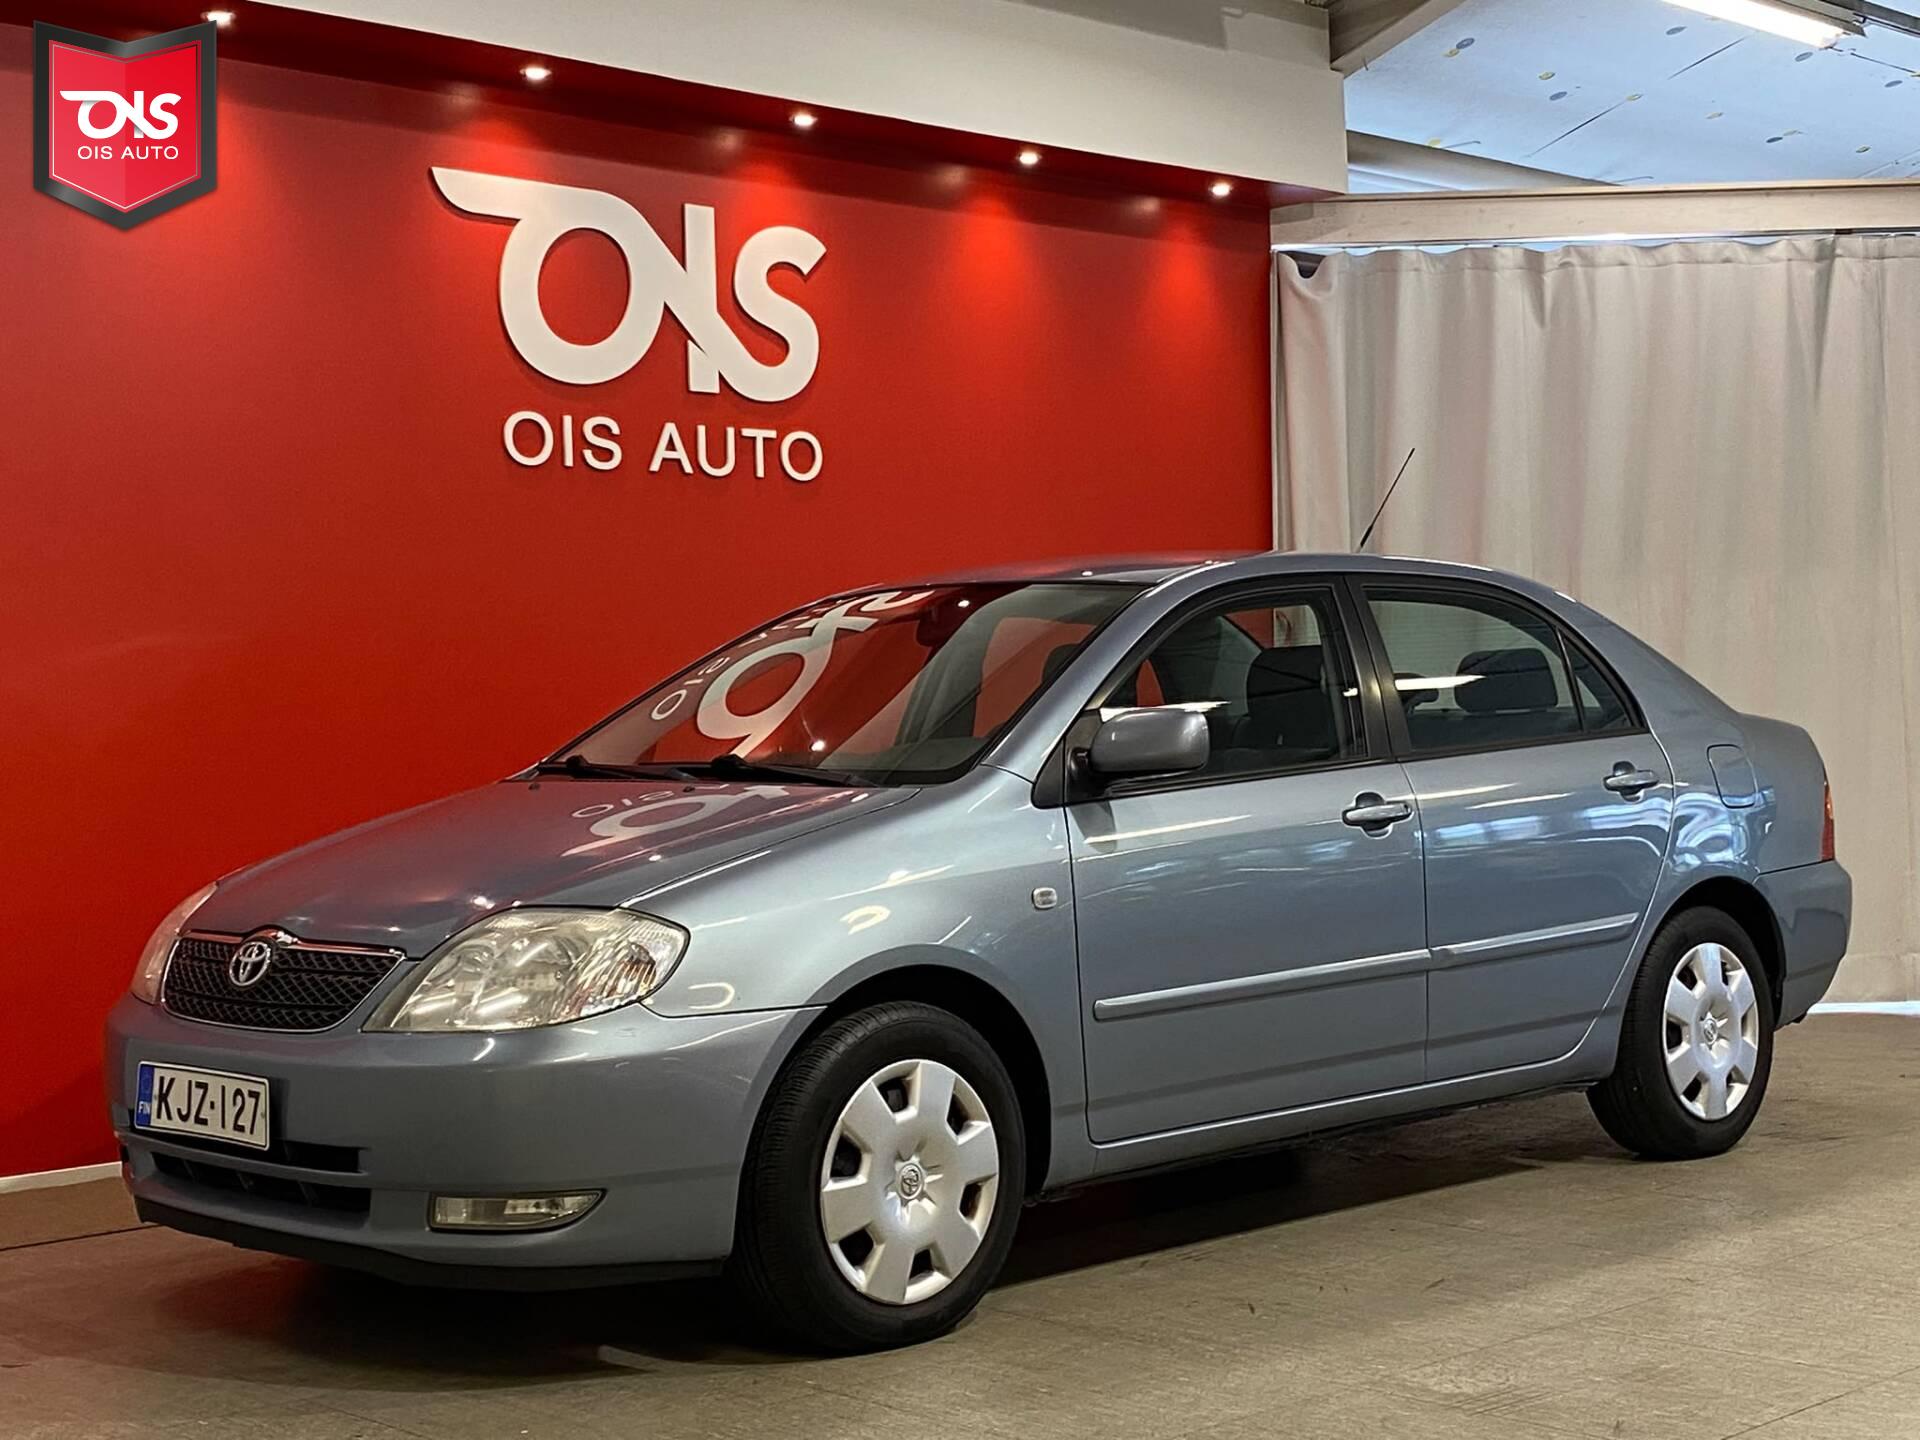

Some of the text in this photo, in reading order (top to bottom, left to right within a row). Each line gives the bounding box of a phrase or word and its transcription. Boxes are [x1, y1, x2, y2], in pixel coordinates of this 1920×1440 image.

[430, 166, 827, 403] OIS
[503, 411, 823, 482] OIS AUTO
[138, 1101, 150, 1115] FIN
[156, 1076, 261, 1135] KJZ-127
